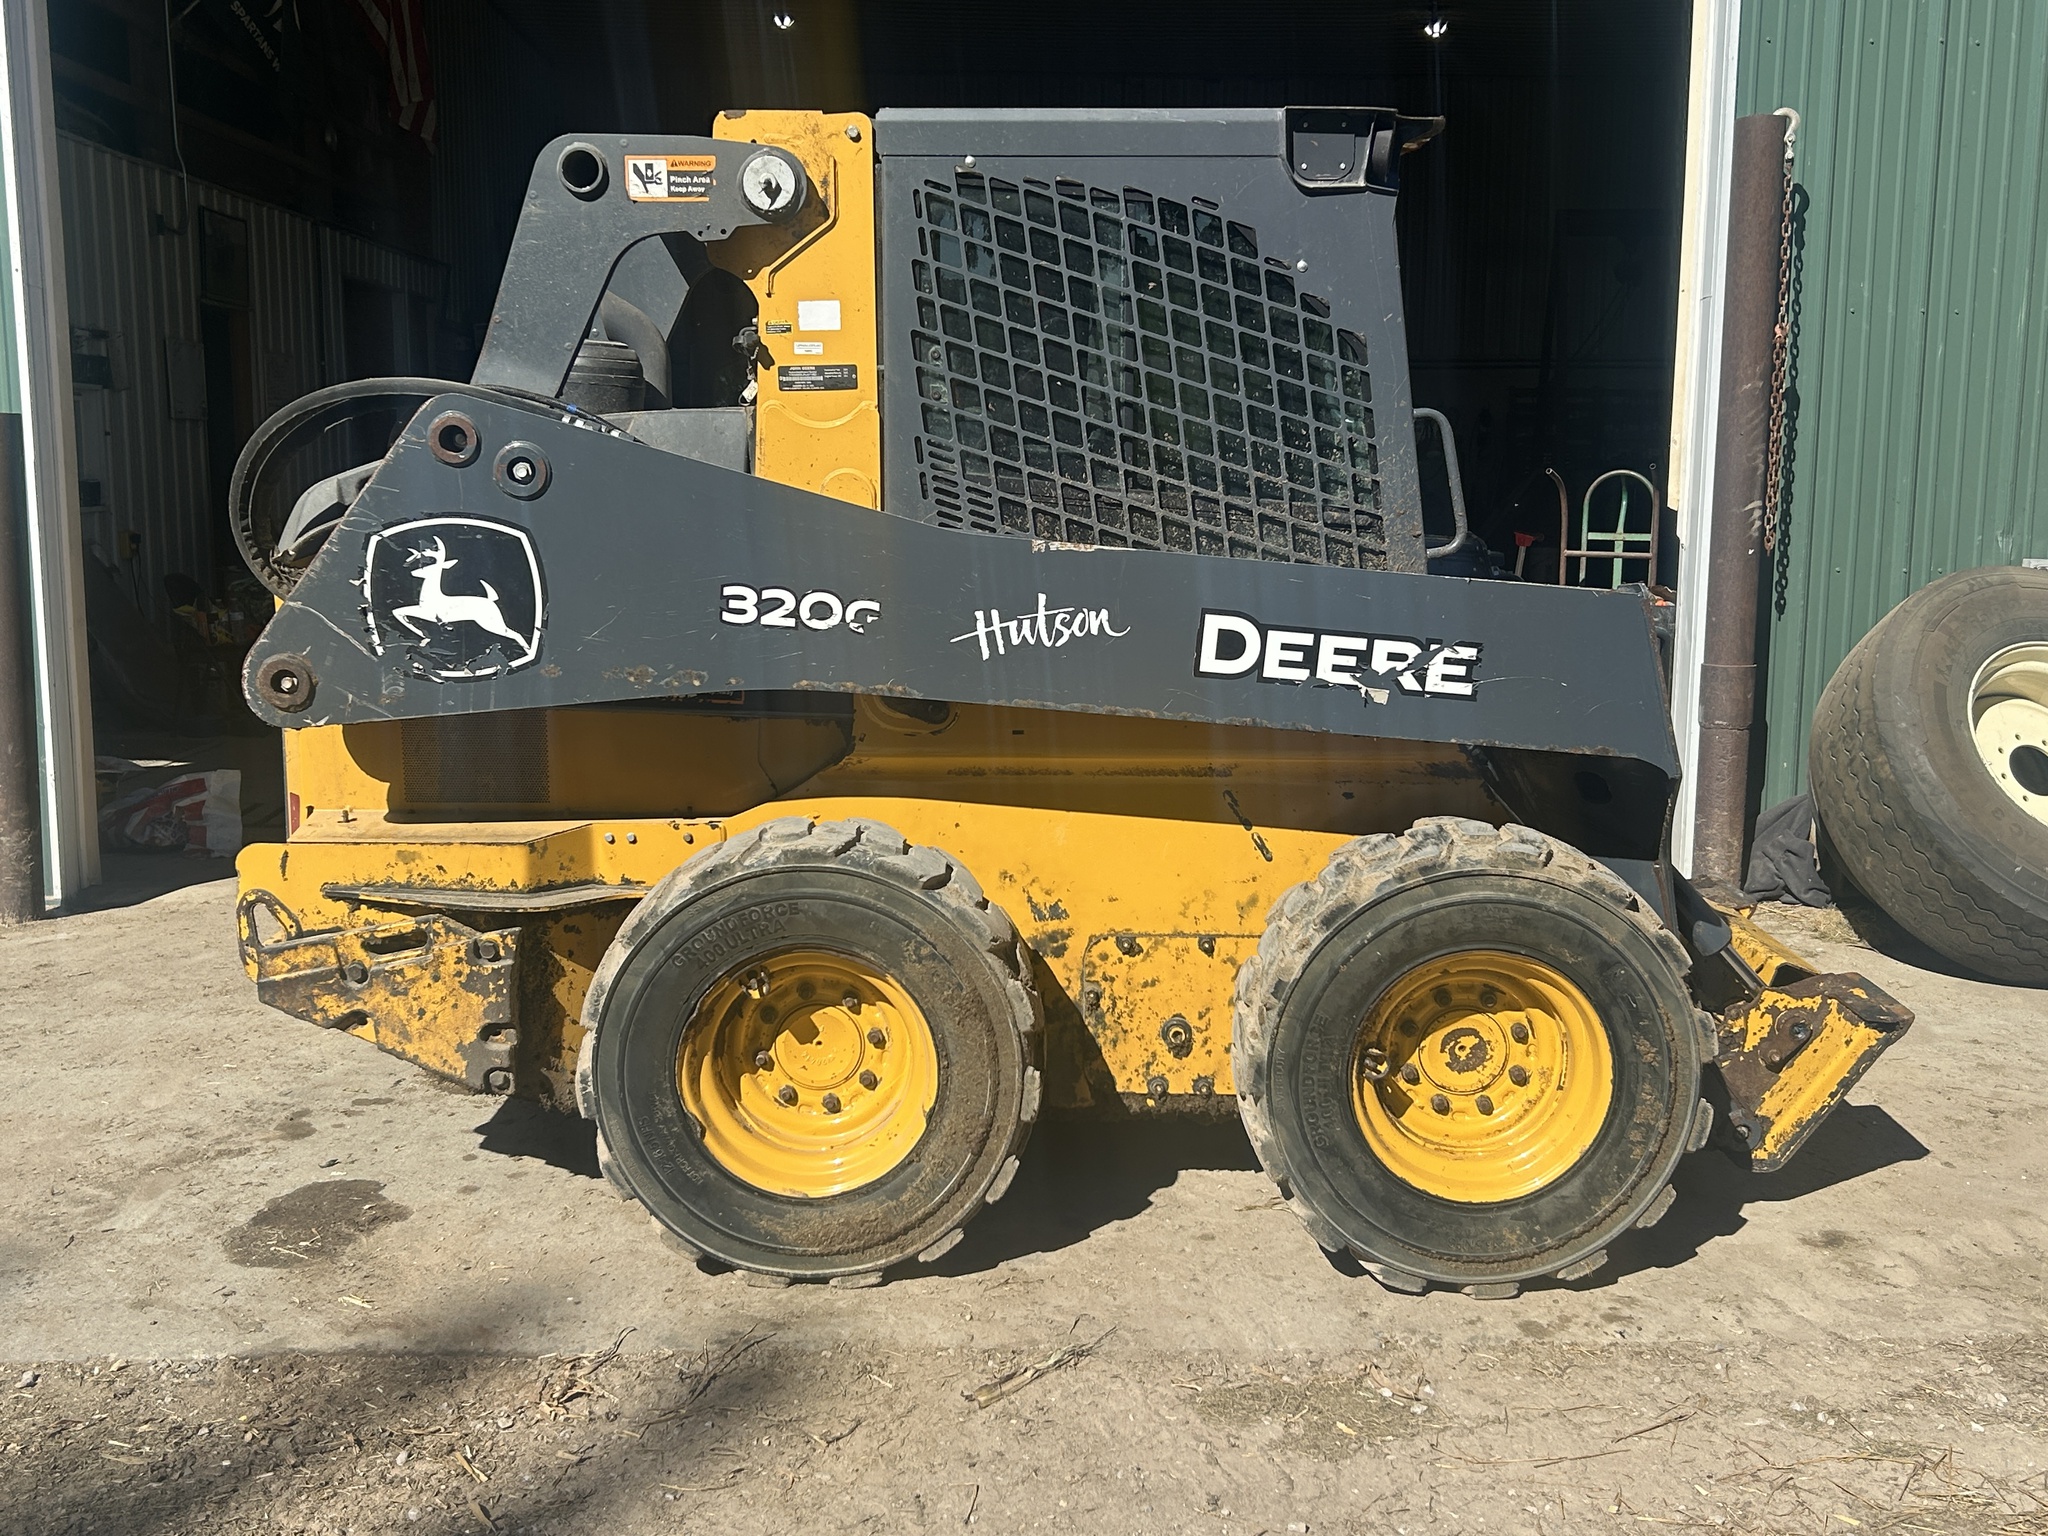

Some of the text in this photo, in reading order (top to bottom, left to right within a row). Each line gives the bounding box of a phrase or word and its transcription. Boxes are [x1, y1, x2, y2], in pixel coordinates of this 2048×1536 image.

[230, 0, 274, 60] SPARTANS
[669, 175, 711, 184] Pinch Area
[670, 185, 706, 194] Keep Away
[950, 592, 1131, 661] Hutson
[1198, 613, 1479, 697] DEERE
[725, 919, 787, 950] ULTRA
